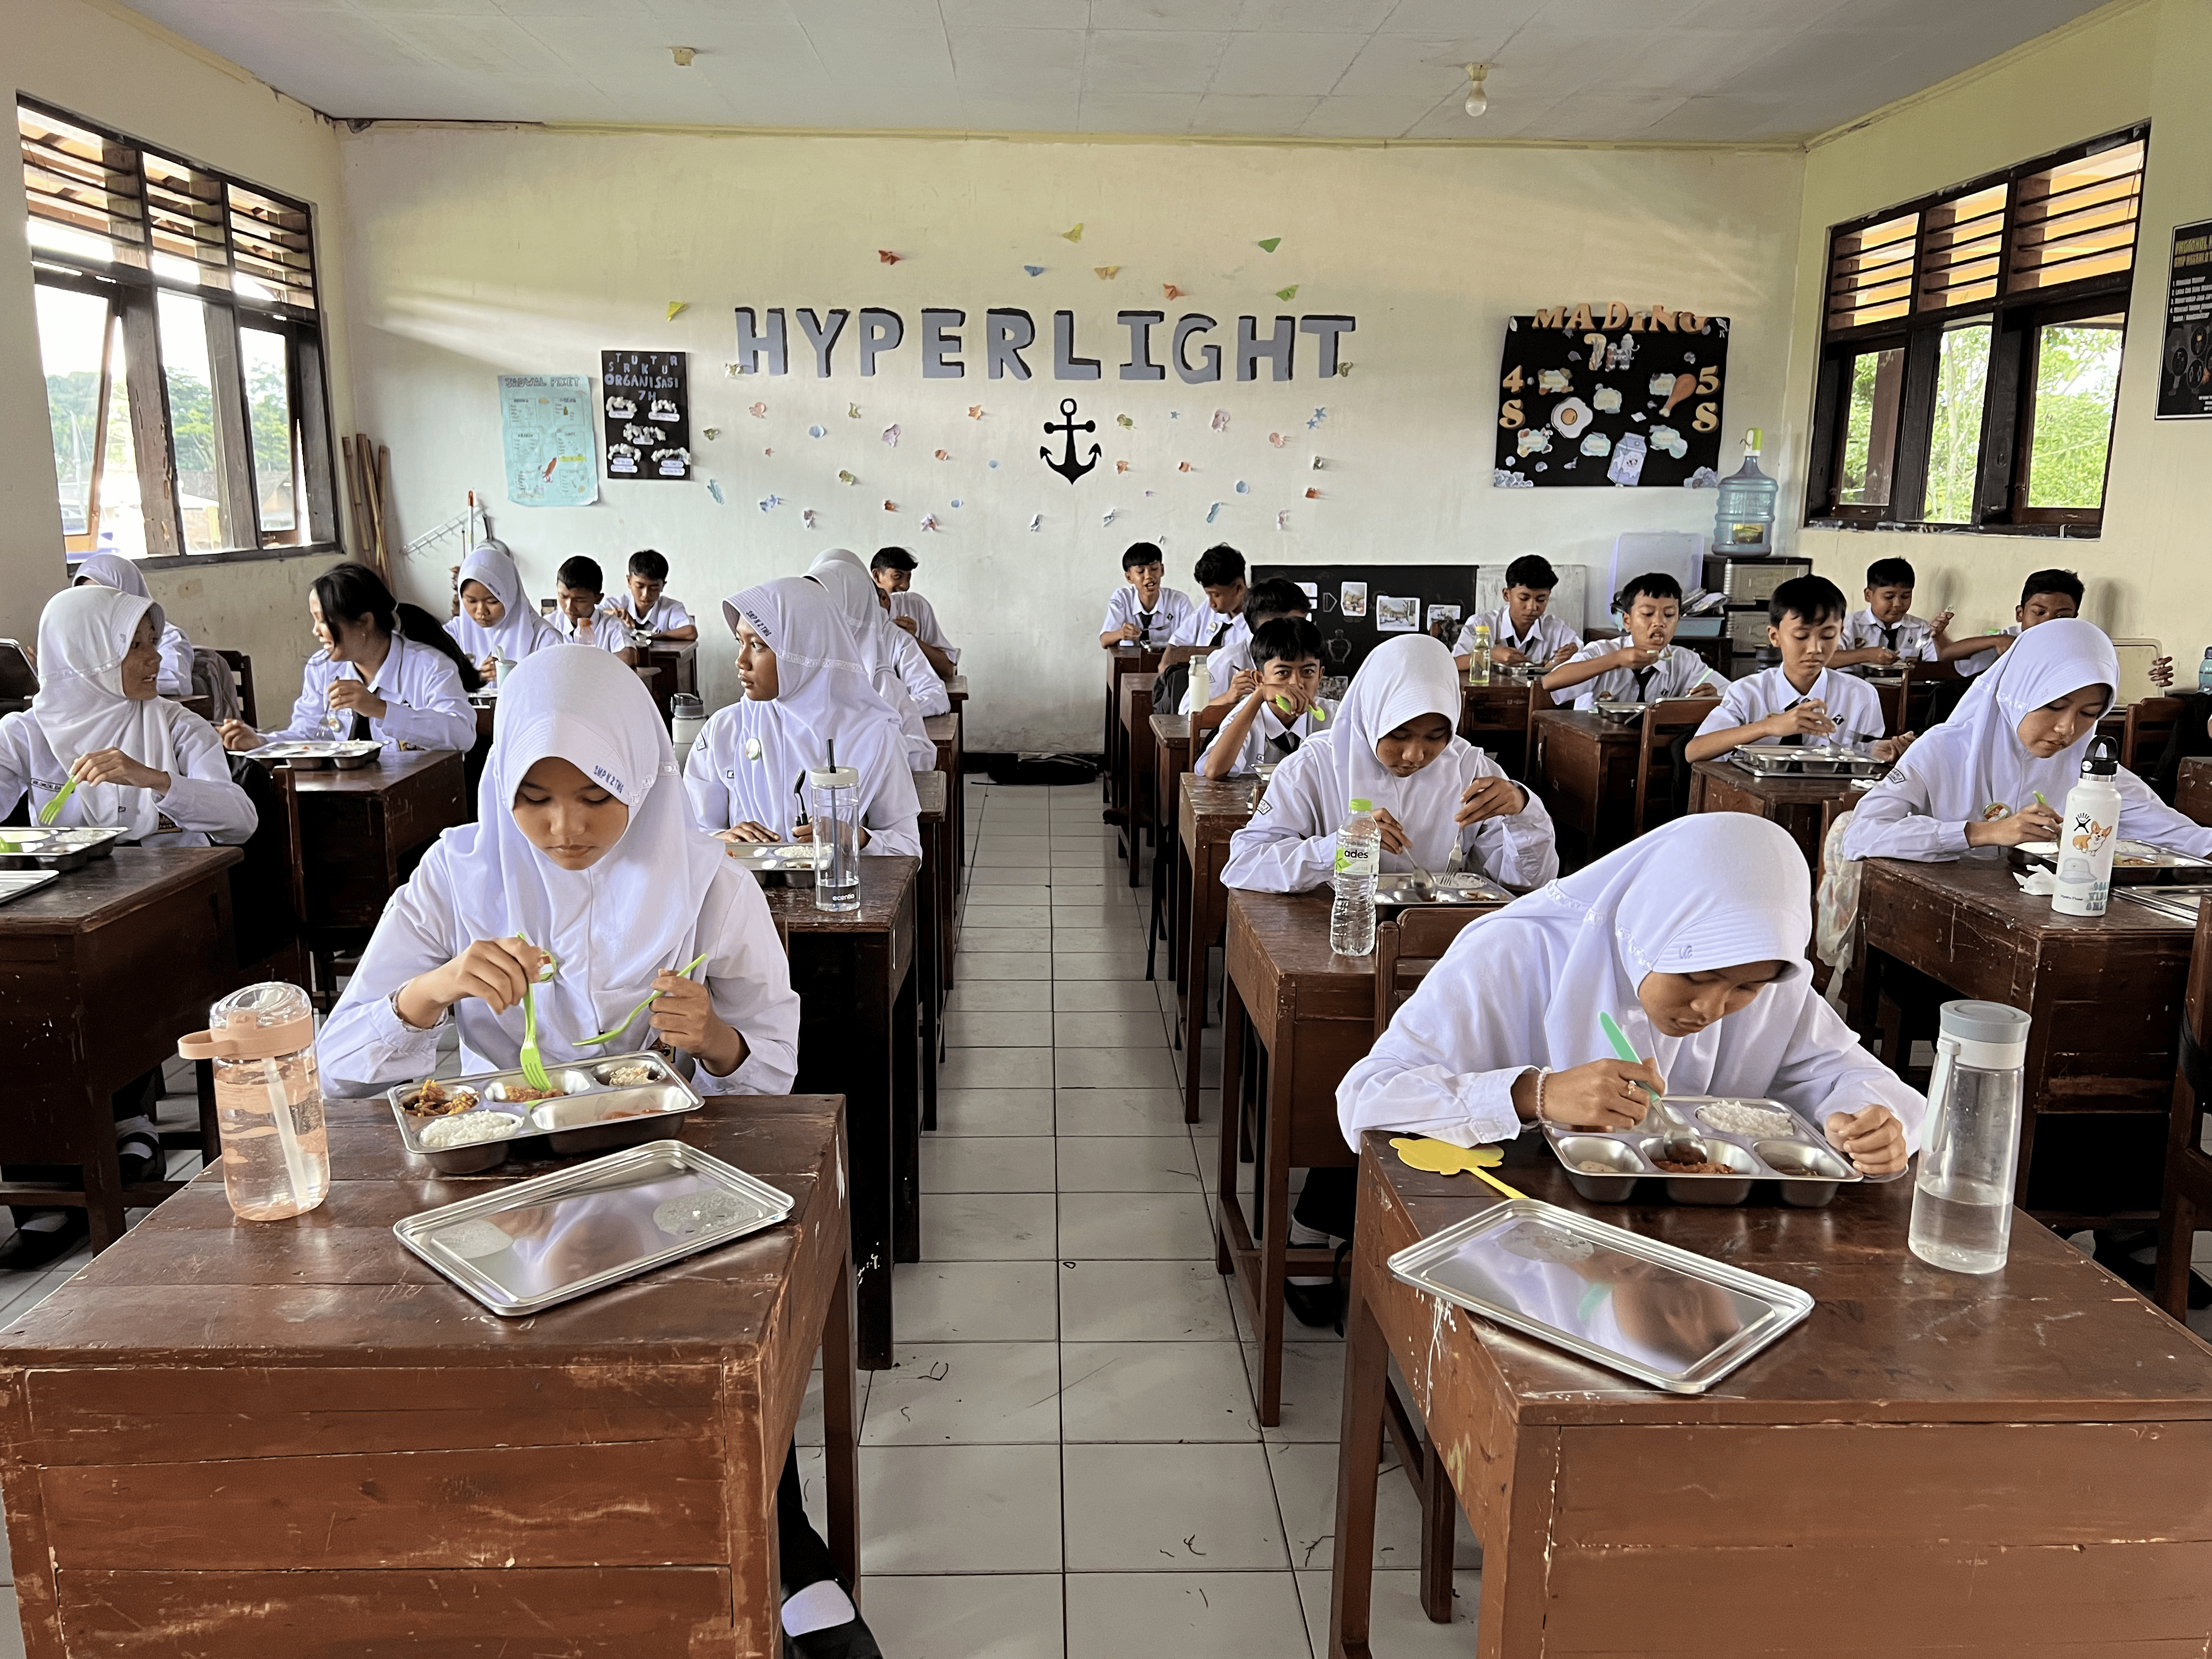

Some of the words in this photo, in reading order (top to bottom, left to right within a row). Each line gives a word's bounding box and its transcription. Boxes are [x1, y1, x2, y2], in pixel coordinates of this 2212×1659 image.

[1531, 301, 1708, 334] MADING
[735, 307, 1355, 384] HYPERLIGHT
[604, 373, 679, 389] ORGANISASI
[638, 390, 656, 401] 7H
[610, 776, 616, 786] 2
[1344, 849, 1369, 859] ades
